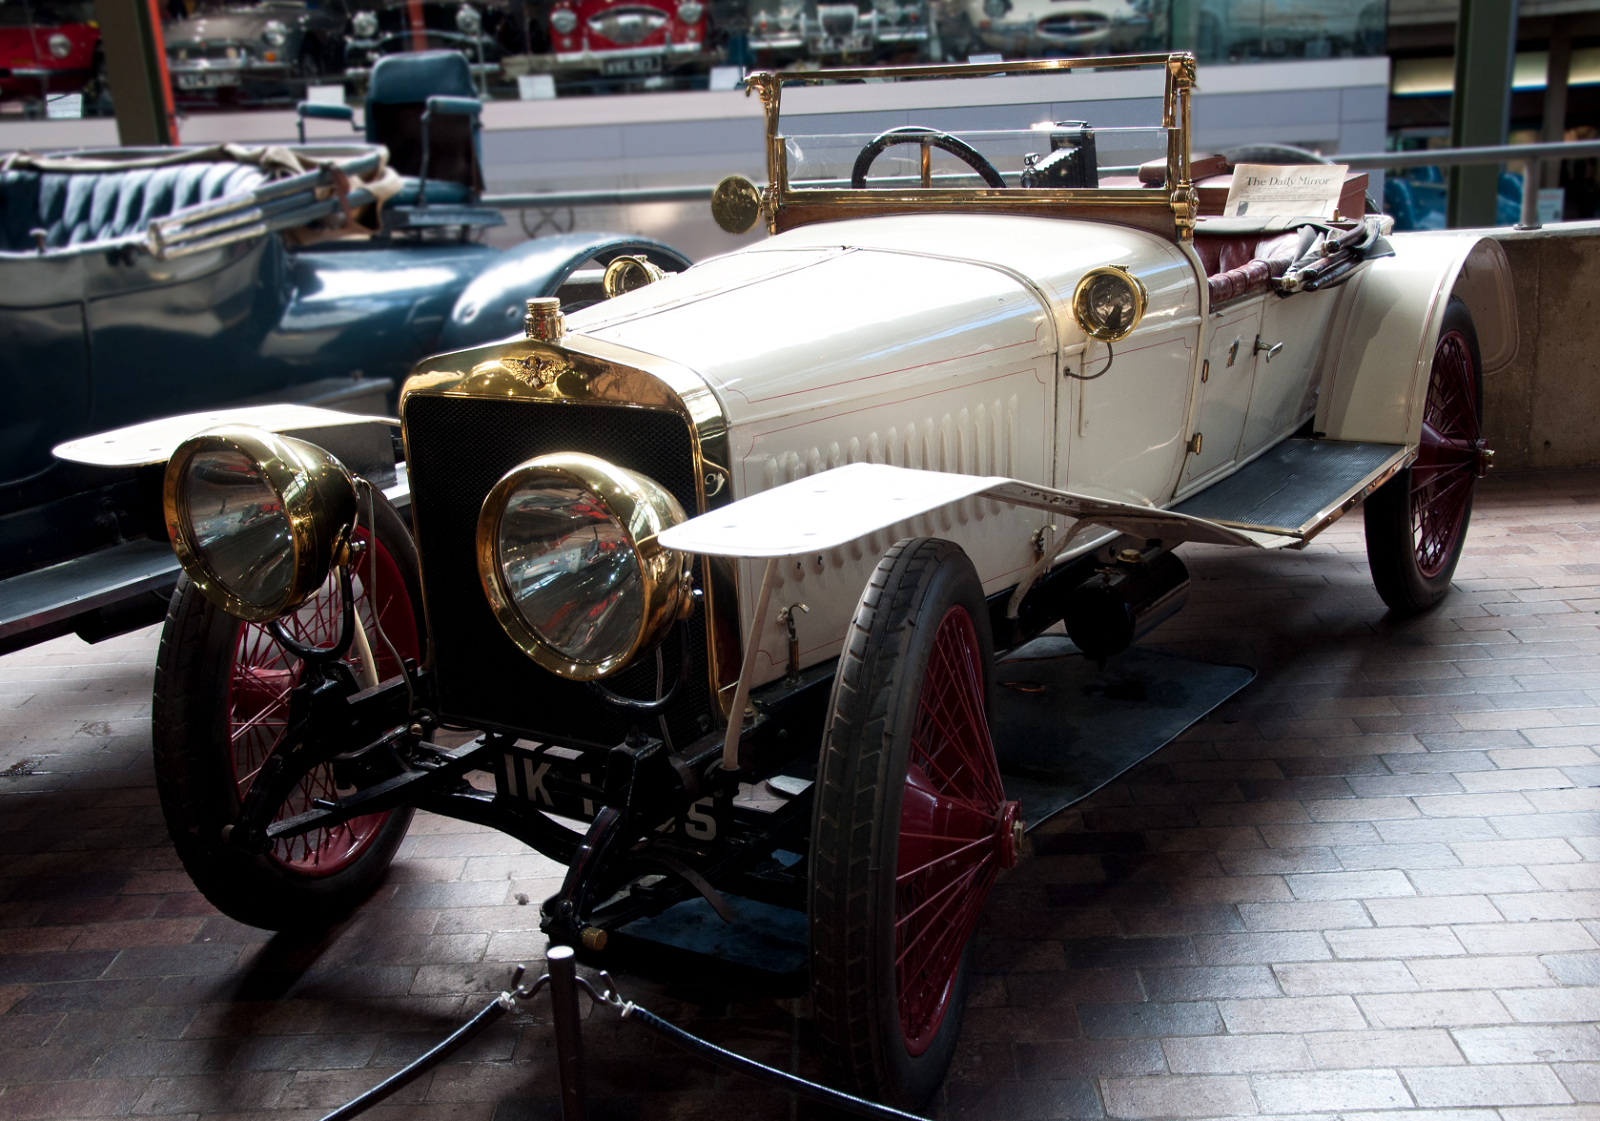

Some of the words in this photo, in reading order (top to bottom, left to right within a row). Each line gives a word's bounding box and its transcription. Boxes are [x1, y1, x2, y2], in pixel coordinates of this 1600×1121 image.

[1246, 176, 1267, 186] The
[1269, 176, 1296, 187] Daily
[1298, 175, 1330, 185] Mirror
[503, 752, 555, 807] IK
